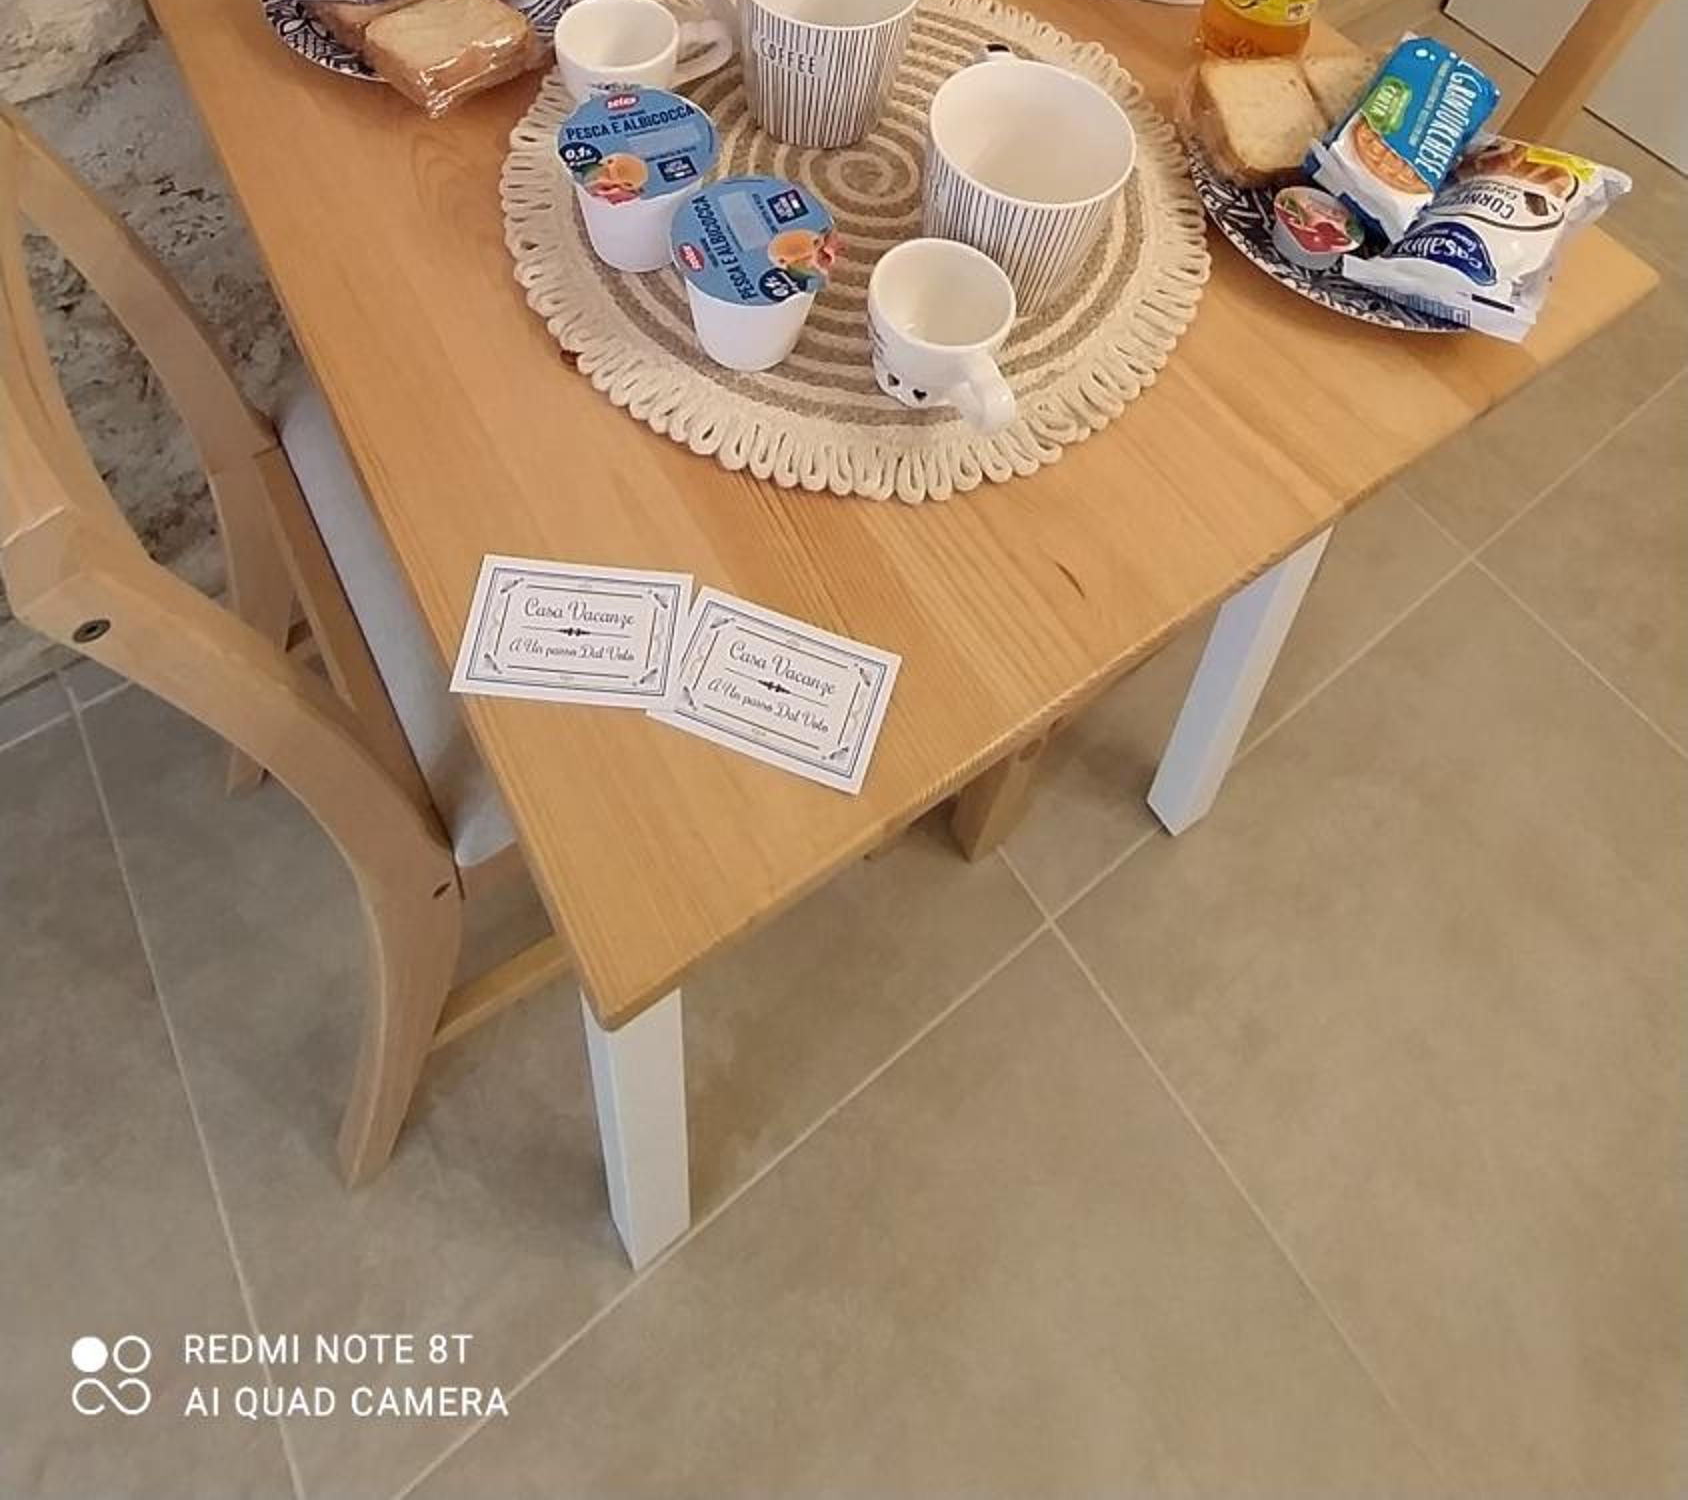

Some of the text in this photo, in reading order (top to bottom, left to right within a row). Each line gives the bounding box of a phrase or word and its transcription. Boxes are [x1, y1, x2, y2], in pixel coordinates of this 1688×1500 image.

[760, 38, 815, 75] COFFEE
[566, 126, 610, 141] PESCA
[613, 122, 623, 134] E
[624, 103, 695, 131] ALBICOCCA
[1414, 71, 1483, 179] GRANTURCHESE
[692, 195, 734, 256] ALBICOCCA
[720, 255, 738, 265] E
[726, 265, 759, 300] PESCA
[524, 597, 635, 629] Casa Vacanze
[509, 637, 522, 653] A
[707, 677, 722, 693] A
[729, 640, 836, 697] Casa Vacanze
